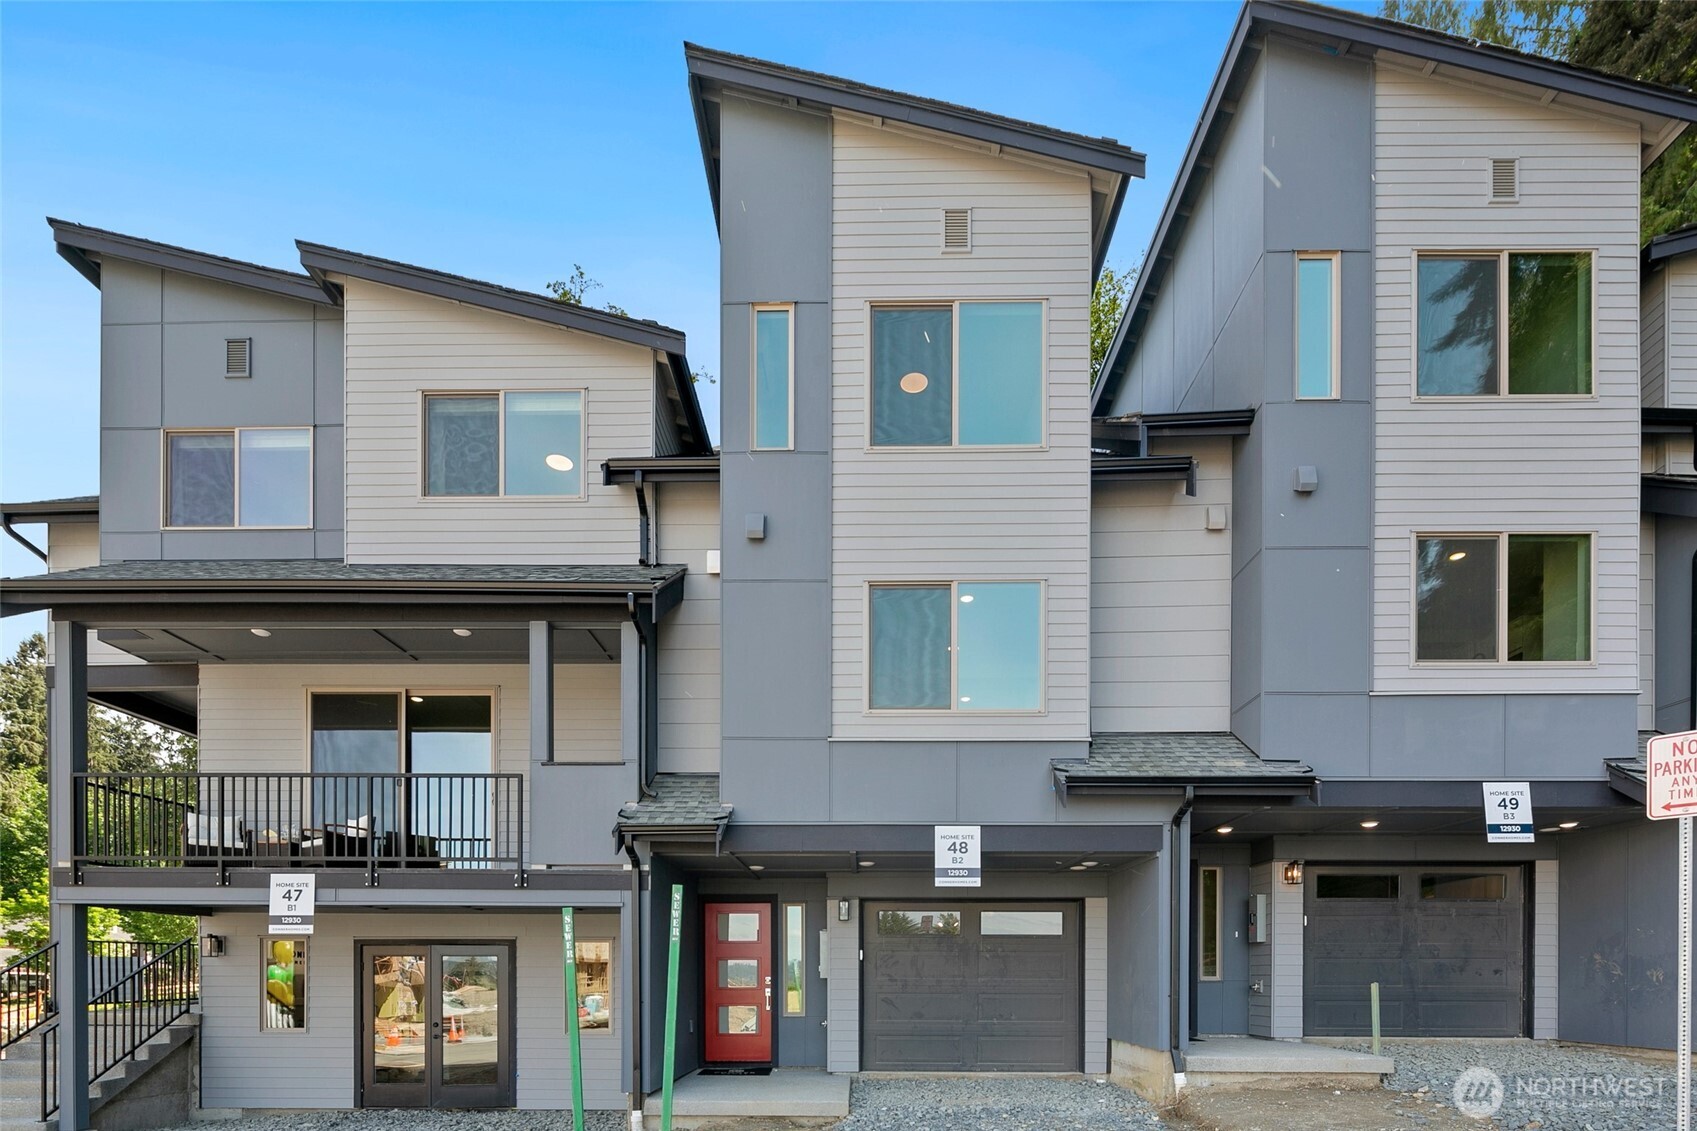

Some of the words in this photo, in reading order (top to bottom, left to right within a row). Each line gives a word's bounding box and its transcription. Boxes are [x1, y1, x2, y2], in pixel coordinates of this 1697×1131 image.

[1672, 739, 1697, 758] NO
[1654, 758, 1697, 778] PARKI
[1668, 787, 1697, 800] TIM
[1497, 797, 1519, 810] 49
[1503, 812, 1515, 820] B3
[947, 841, 969, 854] 48
[951, 856, 964, 864] B2
[282, 889, 303, 902] 47
[672, 892, 680, 936] SEWER
[564, 915, 574, 958] SEWER
